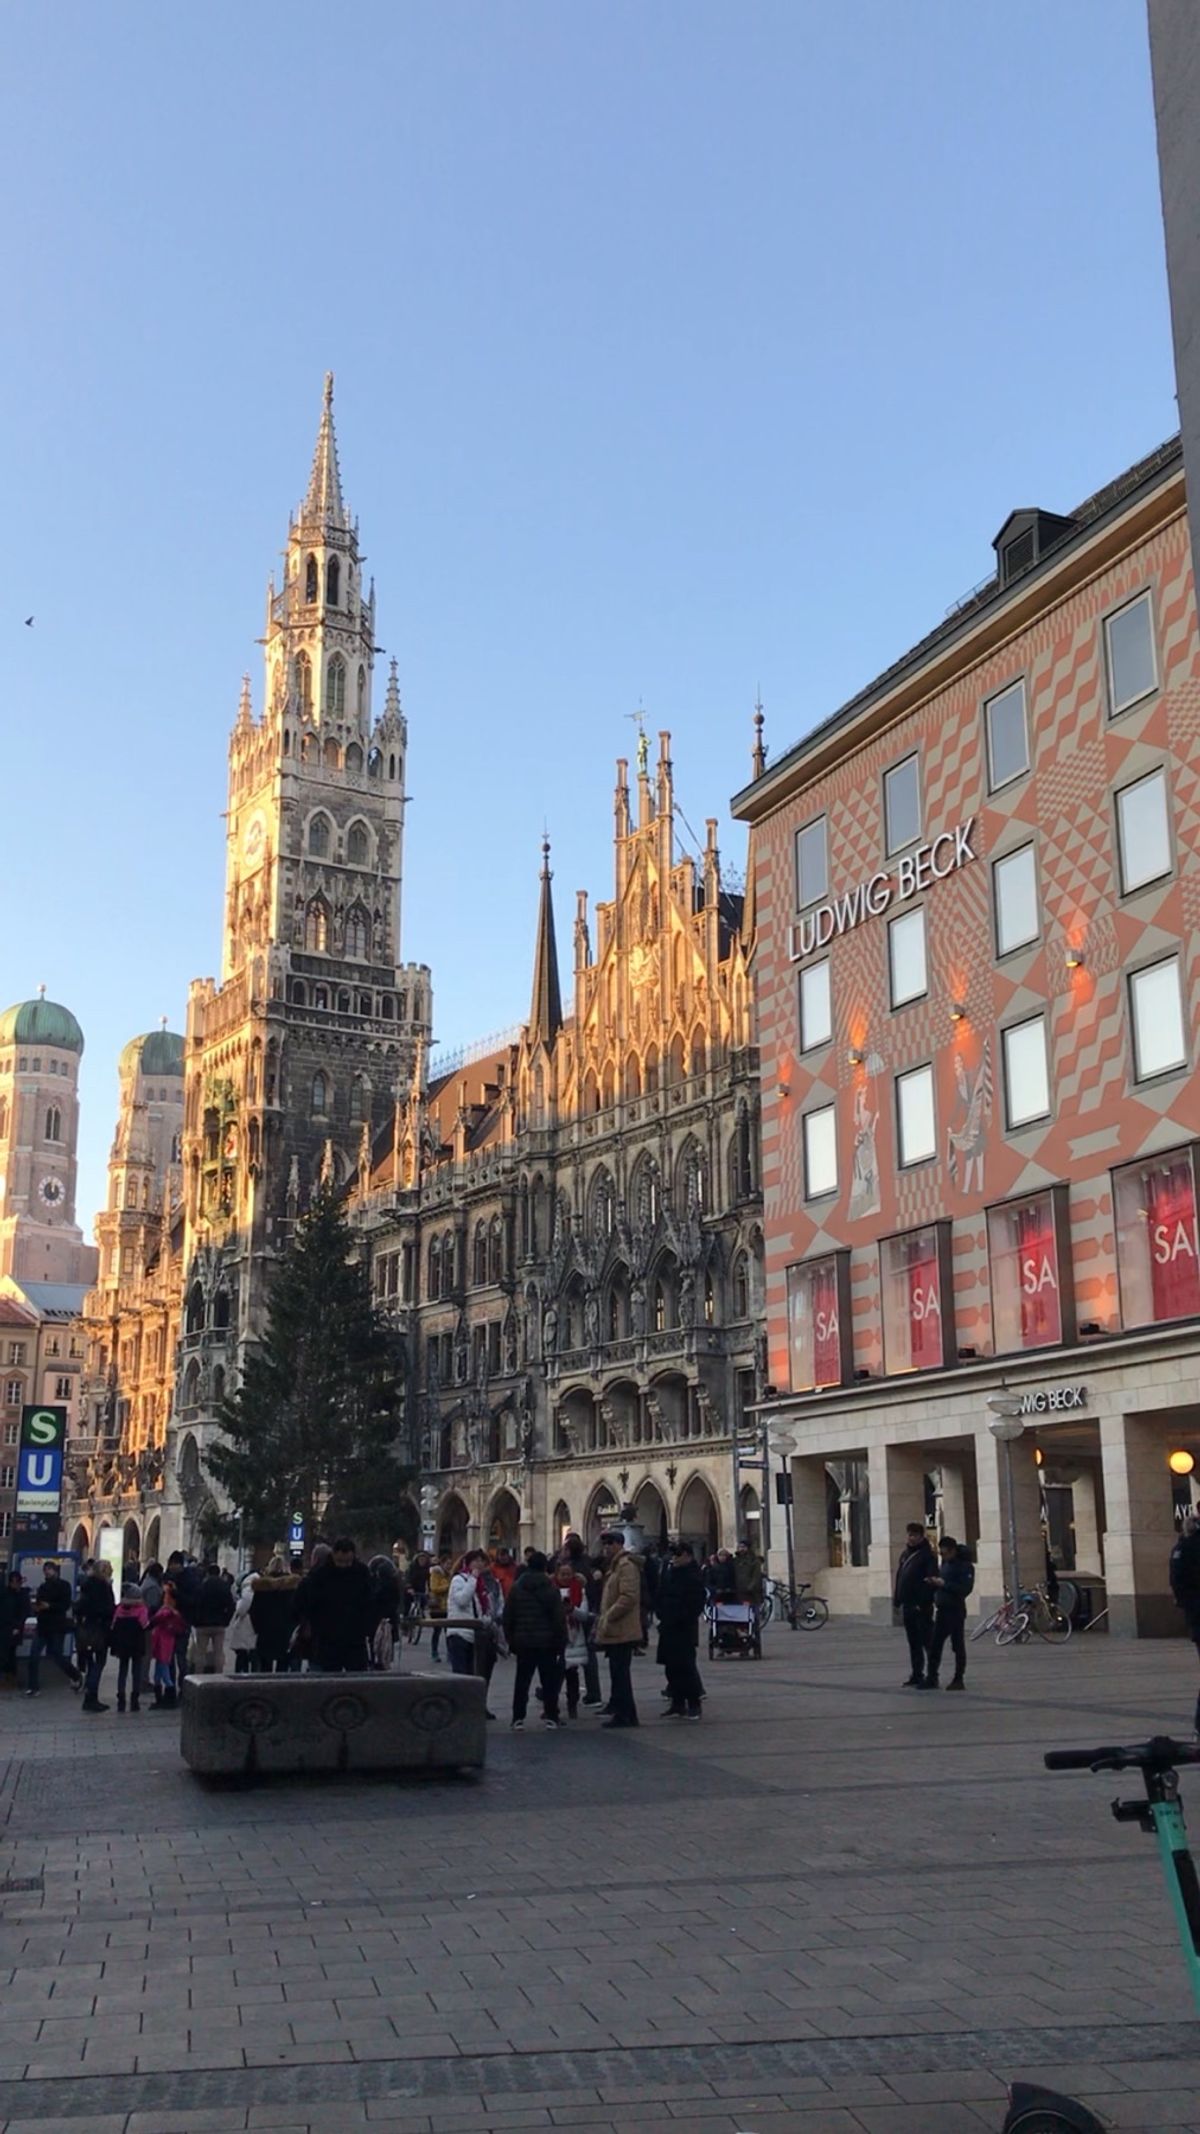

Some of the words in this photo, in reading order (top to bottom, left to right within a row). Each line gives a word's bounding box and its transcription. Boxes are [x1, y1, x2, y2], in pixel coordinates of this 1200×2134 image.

[788, 872, 892, 962] LUDWIG
[899, 816, 976, 899] BECK
[1013, 1391, 1046, 1414] WIG
[1049, 1386, 1083, 1410] BECK
[30, 1411, 57, 1444] S
[27, 1454, 53, 1486] U
[292, 1511, 303, 1525] S
[292, 1527, 302, 1540] U
